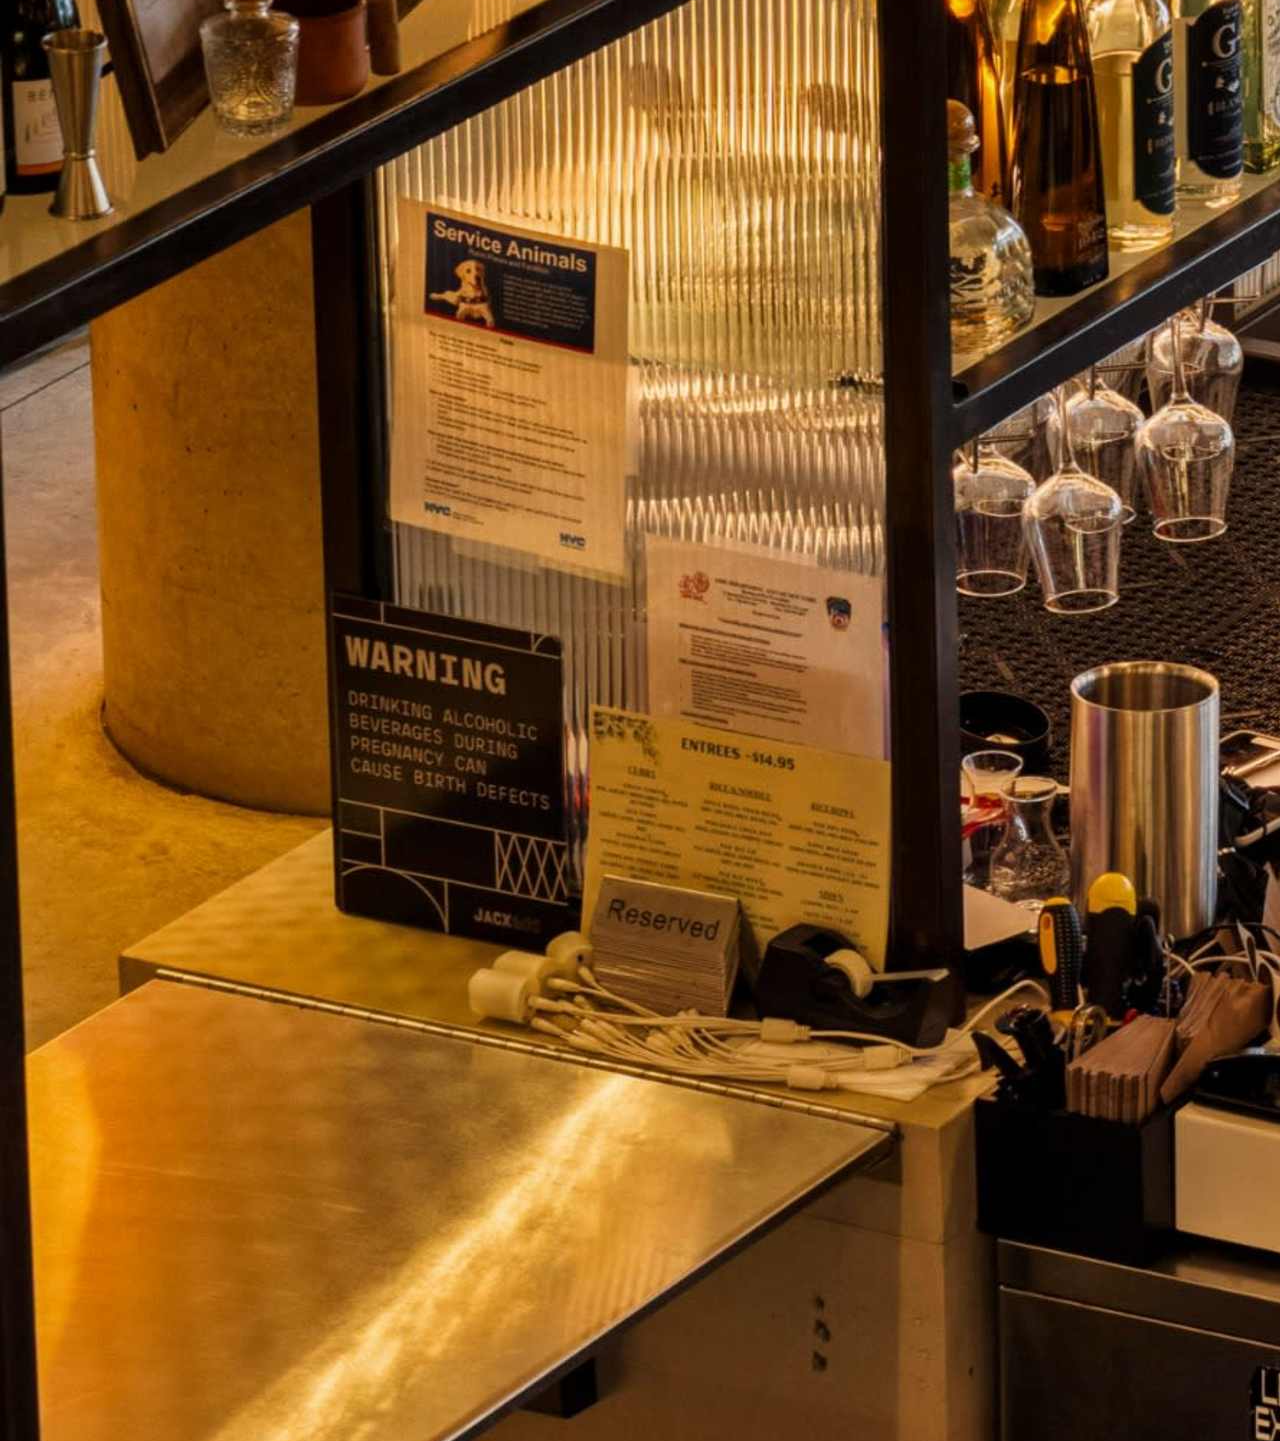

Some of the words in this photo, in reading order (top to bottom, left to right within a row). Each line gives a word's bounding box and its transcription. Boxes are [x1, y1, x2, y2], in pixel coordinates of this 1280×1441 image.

[434, 219, 502, 255] Service
[506, 239, 589, 273] Animals
[344, 635, 507, 696] WARNING
[348, 690, 433, 722] DRINKING
[442, 708, 539, 742] ALCOHOLIC
[349, 713, 444, 746] BEVERAGES
[454, 733, 520, 760] DURING
[350, 734, 445, 768] PREGNANCY
[454, 756, 488, 776] CAN
[680, 736, 741, 761] ENTREES
[350, 757, 403, 783] CAUSE
[413, 770, 468, 796] BIRTH
[476, 781, 551, 812] DEFECTS
[607, 898, 720, 942] Reserved
